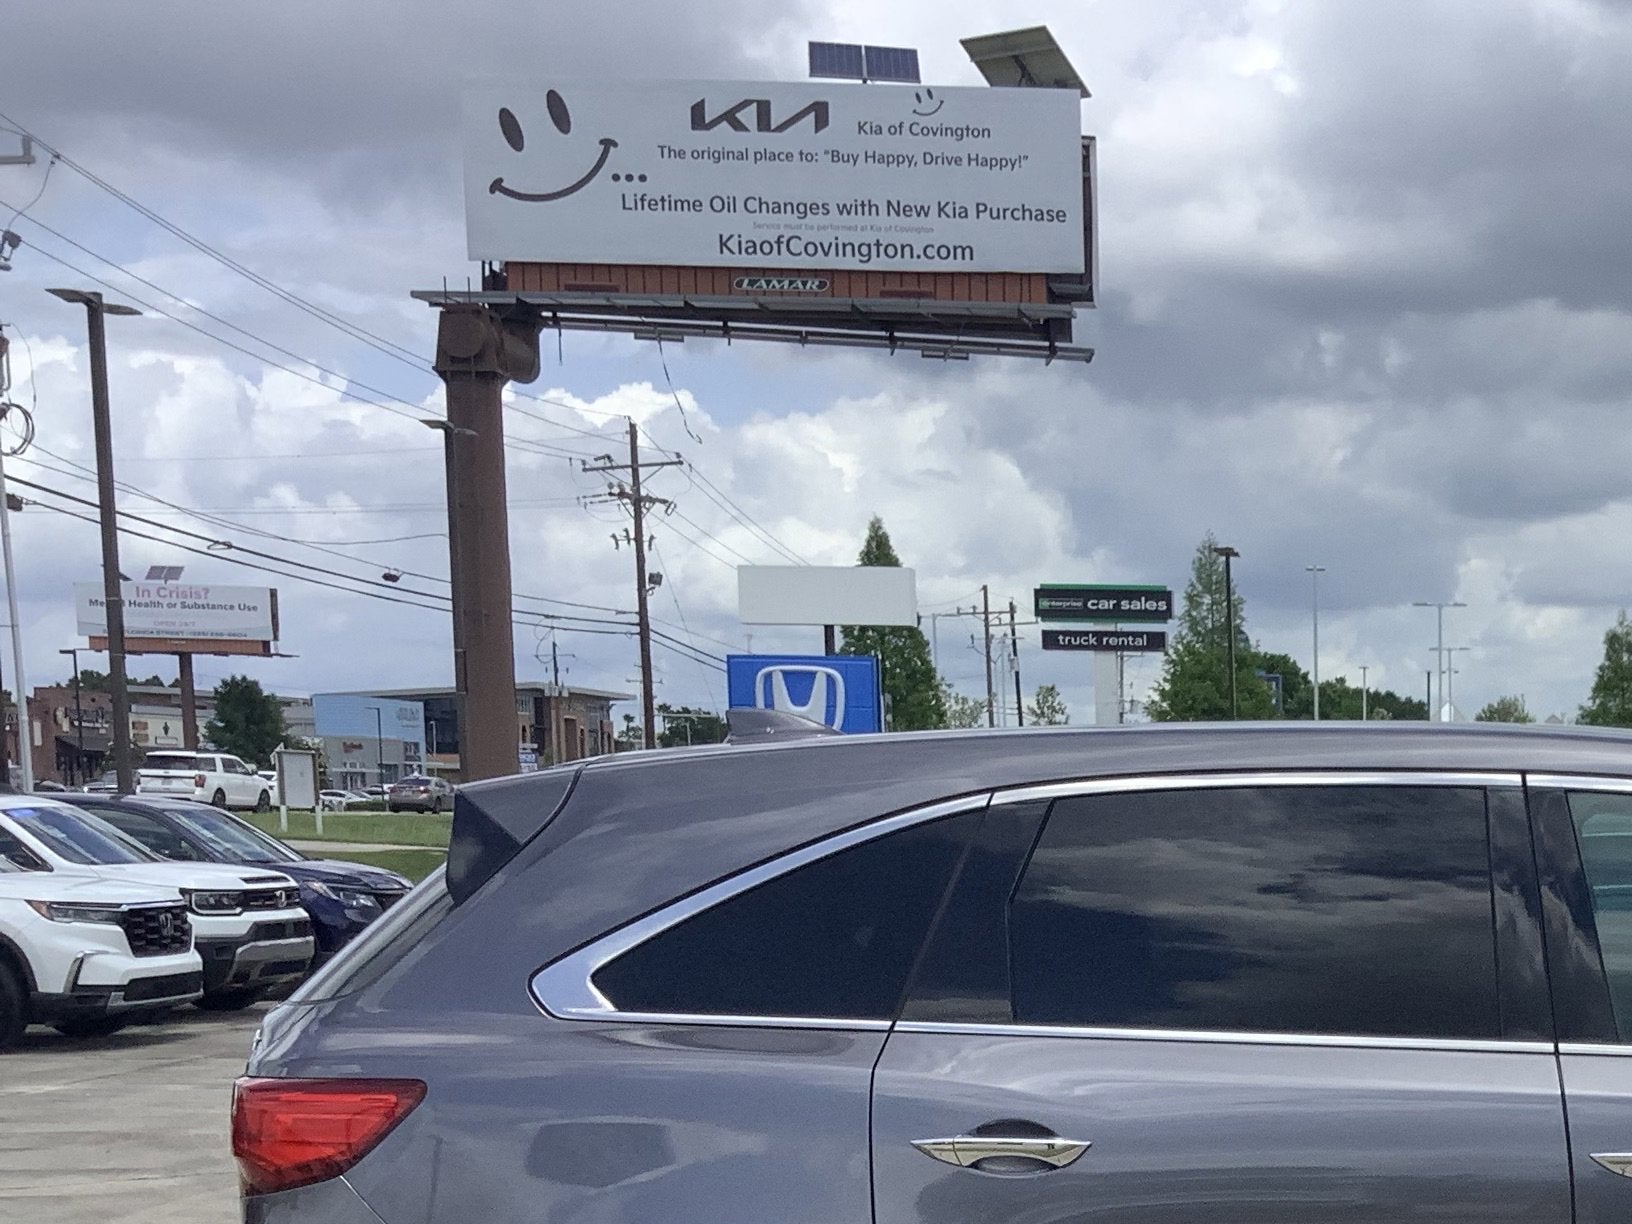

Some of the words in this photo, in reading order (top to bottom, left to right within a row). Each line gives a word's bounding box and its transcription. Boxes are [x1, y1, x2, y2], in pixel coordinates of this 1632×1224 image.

[691, 98, 829, 135] KIA
[857, 121, 883, 136] Kia
[888, 121, 904, 136] of
[909, 121, 991, 141] Covington
[657, 144, 686, 160] The
[690, 146, 749, 164] original
[754, 147, 794, 165] place
[799, 149, 819, 163] to:
[864, 151, 918, 168] Happy,
[922, 151, 963, 167] Drive
[621, 192, 703, 213] Lifetime
[709, 194, 737, 214] Oil
[743, 196, 830, 219] Changes
[836, 199, 880, 217] with
[886, 199, 931, 218] New
[937, 200, 969, 219] Kia
[975, 202, 1067, 223] Purchase
[718, 234, 975, 263] KiaofCovington.com
[741, 278, 821, 290] LAMAR
[135, 586, 150, 599] In
[156, 586, 210, 600] Crisis?
[128, 599, 164, 610] Health
[167, 602, 177, 610] or
[180, 601, 235, 611] Substance
[237, 602, 258, 612] Use
[1086, 599, 1117, 610] car
[1120, 596, 1167, 611] sales
[1057, 633, 1098, 646] truck
[1102, 634, 1147, 646] rental
